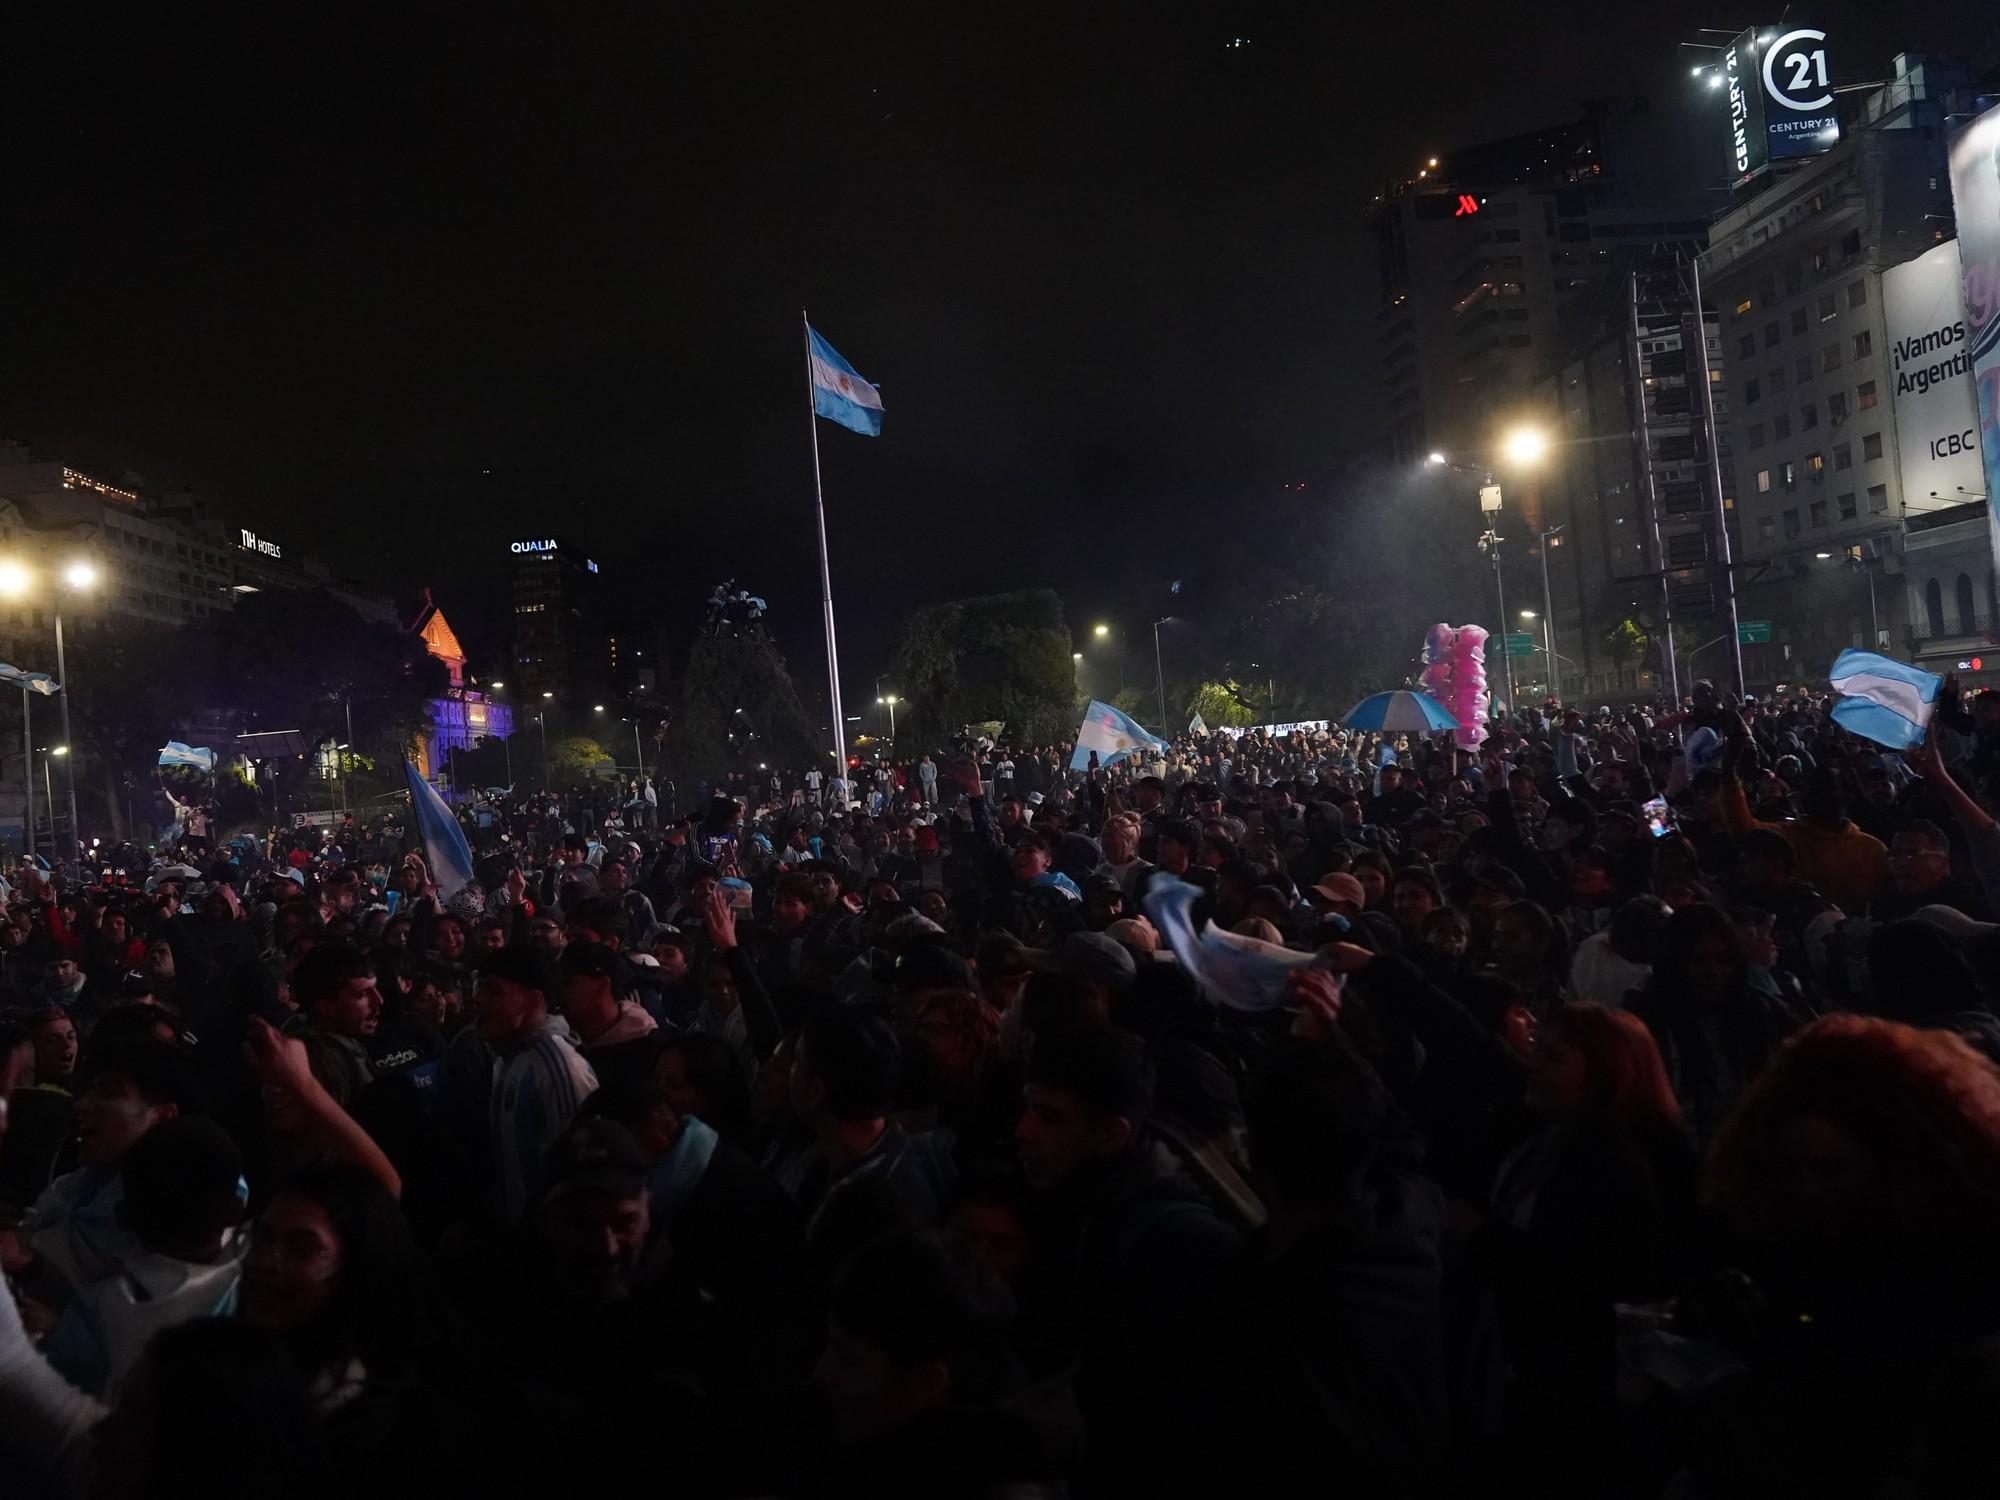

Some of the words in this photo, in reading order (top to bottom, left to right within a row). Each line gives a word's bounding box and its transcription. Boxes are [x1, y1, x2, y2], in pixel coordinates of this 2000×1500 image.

[1728, 76, 1749, 172] CENTURY
[1769, 119, 1823, 133] CENTURY
[1825, 117, 1837, 128] 21
[1893, 321, 1966, 370] ¡Vamos
[1930, 429, 1976, 461] ICBC
[257, 538, 281, 559] HOTELS
[510, 539, 558, 553] QUALIA
